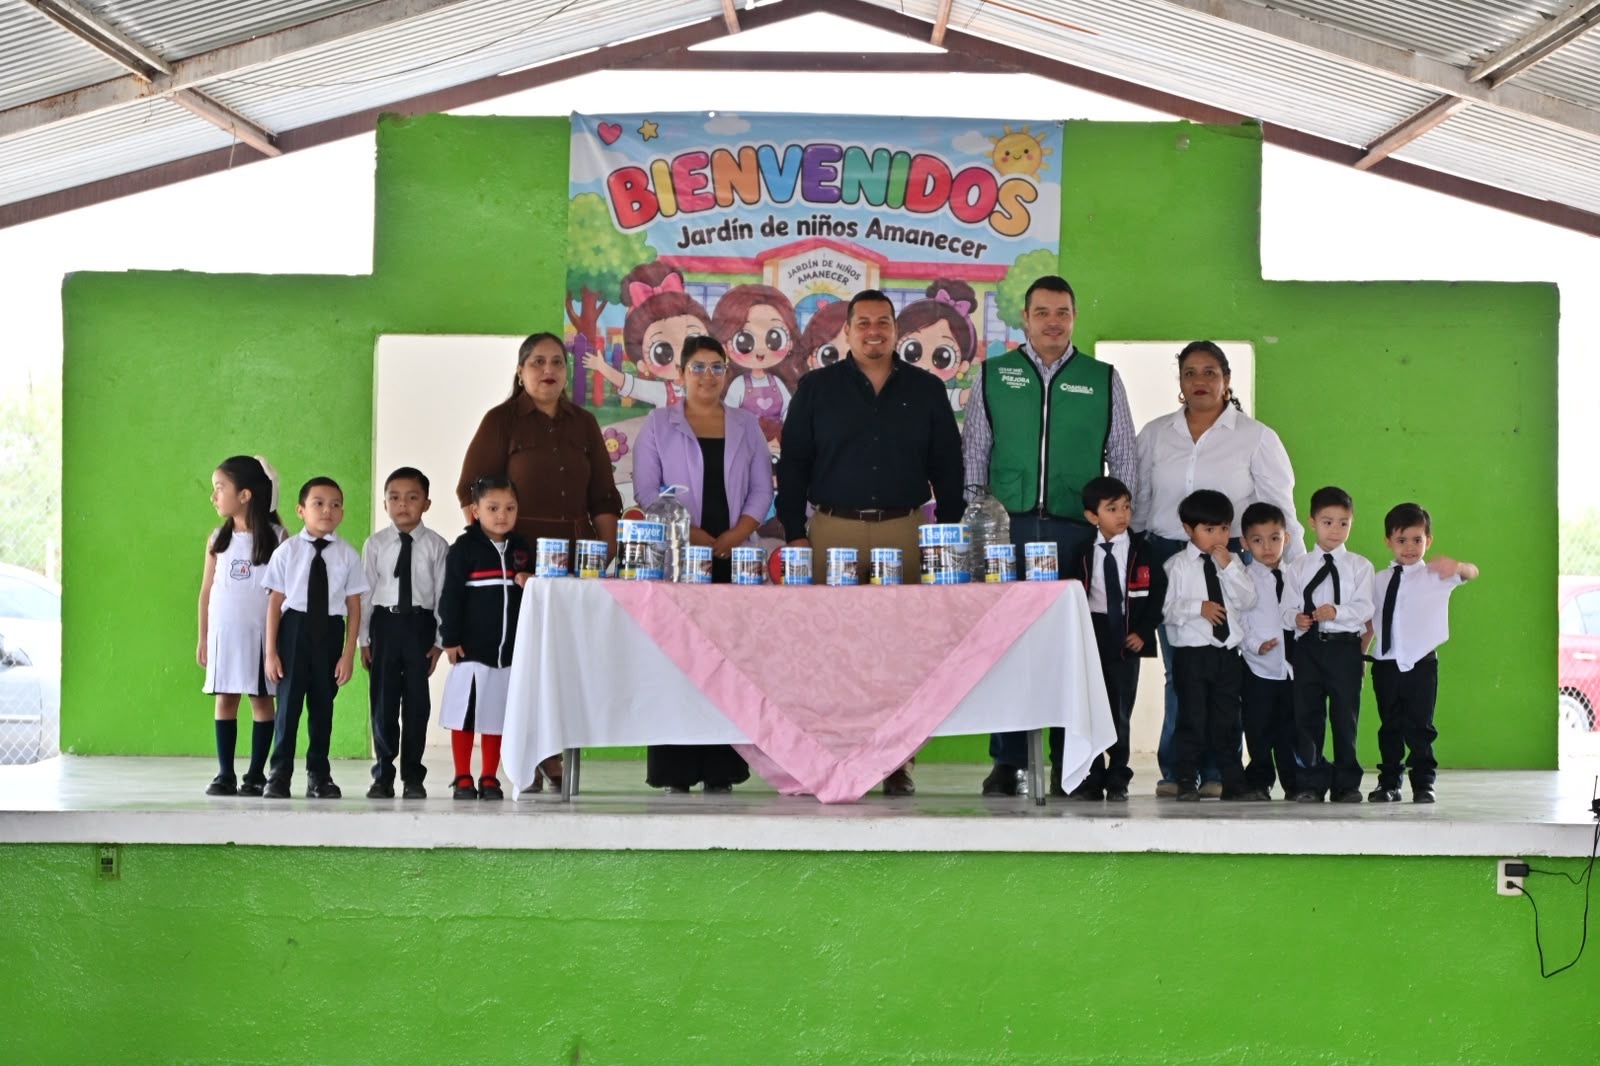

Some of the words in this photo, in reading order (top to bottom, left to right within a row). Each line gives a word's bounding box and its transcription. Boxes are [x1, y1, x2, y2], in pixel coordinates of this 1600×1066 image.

[607, 143, 1038, 237] BIENVENIDOS
[677, 216, 753, 249] Jardín
[760, 215, 789, 237] de
[796, 215, 858, 238] niños
[865, 217, 987, 259] Amanecer
[787, 259, 819, 279] JARDÍN
[822, 260, 833, 268] DE
[836, 263, 861, 280] NIÑOS
[798, 270, 850, 286] AMANECER
[926, 529, 958, 541] Sayer
